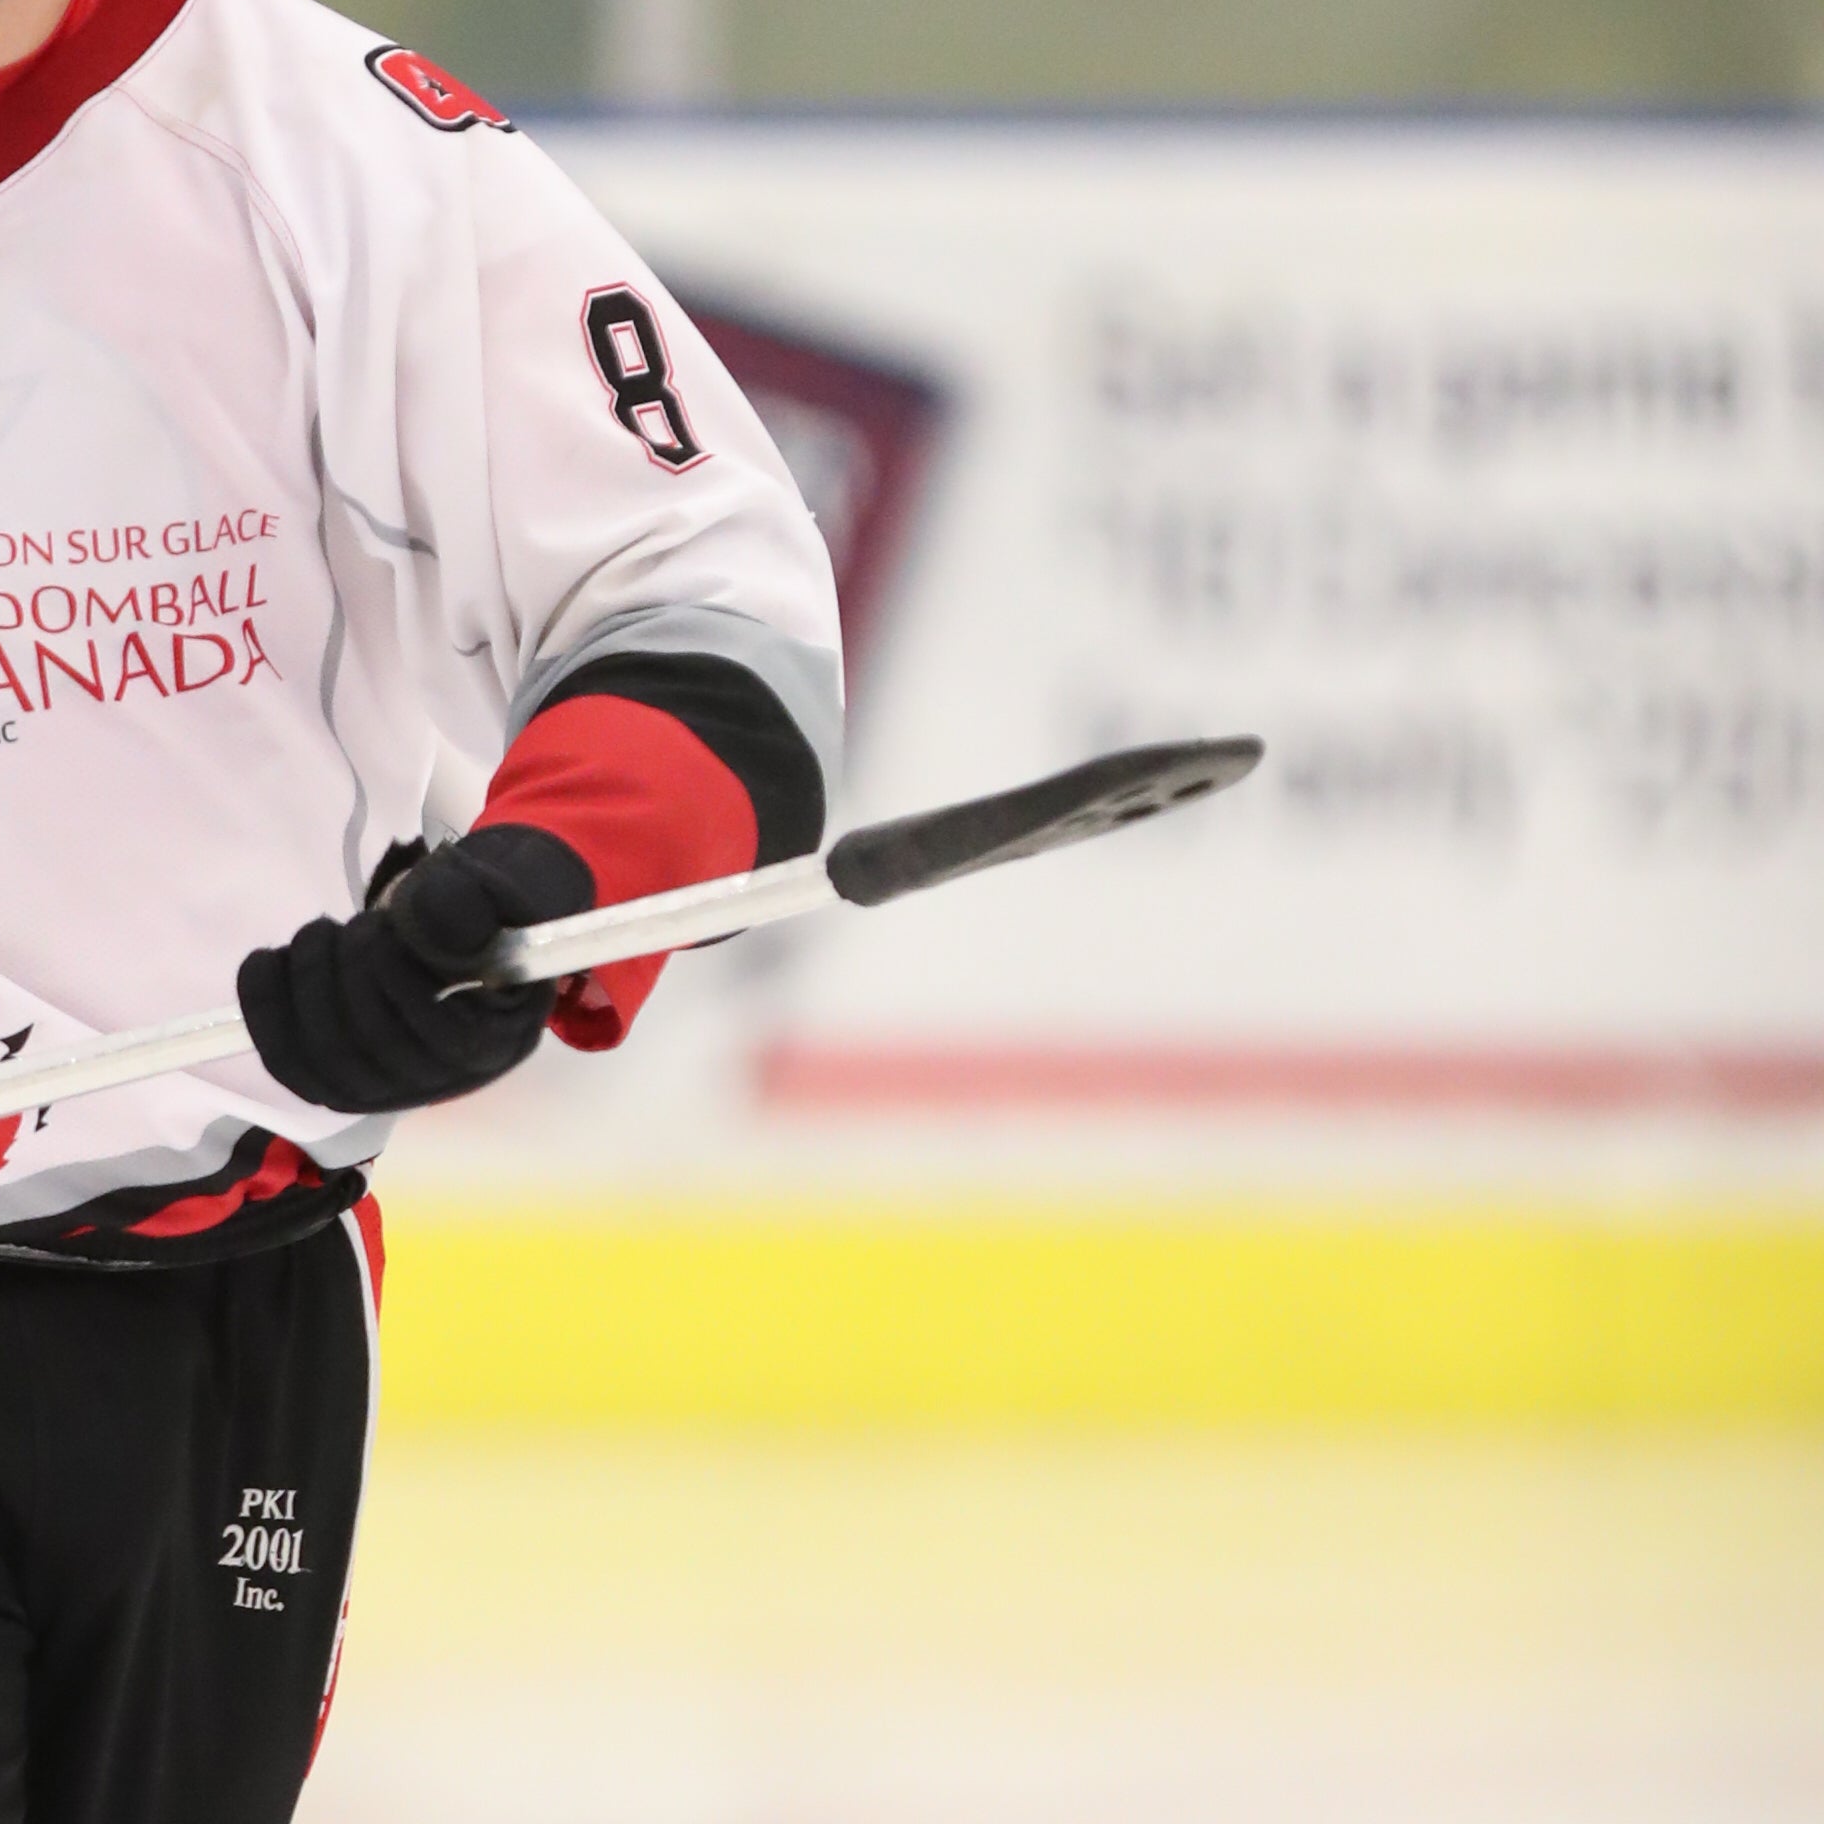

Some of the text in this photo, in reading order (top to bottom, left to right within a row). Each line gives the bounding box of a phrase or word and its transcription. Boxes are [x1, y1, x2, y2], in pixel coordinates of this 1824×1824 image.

[580, 281, 716, 475] 8
[66, 525, 153, 564] SUR
[162, 509, 280, 556] GLACE
[238, 1488, 298, 1520] PKI
[218, 1524, 305, 1574] 2001
[233, 1577, 285, 1612] Inc.
